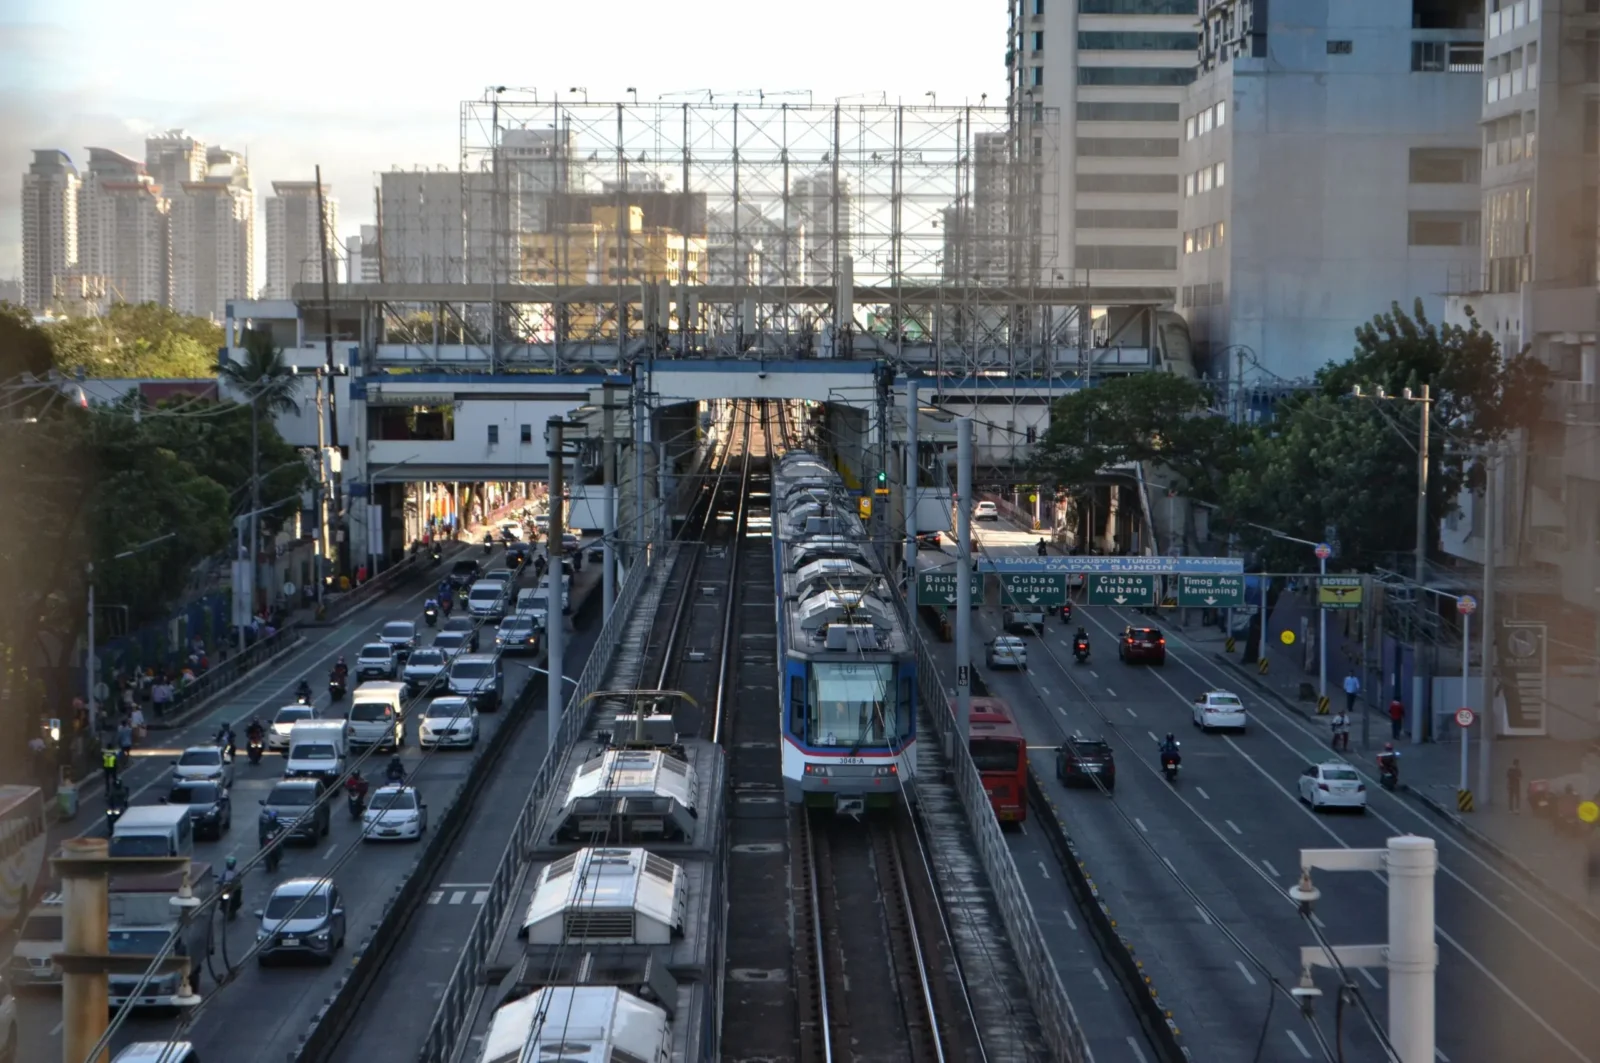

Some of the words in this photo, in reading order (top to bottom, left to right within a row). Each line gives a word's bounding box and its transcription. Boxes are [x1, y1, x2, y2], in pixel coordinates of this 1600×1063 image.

[1012, 575, 1055, 584] Cubao
[1100, 576, 1143, 584] Cubao
[1183, 577, 1213, 587] Timog
[1219, 577, 1240, 585] Ave.
[1322, 577, 1360, 586] BOYSEN
[926, 584, 977, 594] Alabg
[1007, 584, 1060, 593] Baclaran
[1096, 586, 1147, 596] Alabang
[1184, 586, 1238, 597] Kamuning
